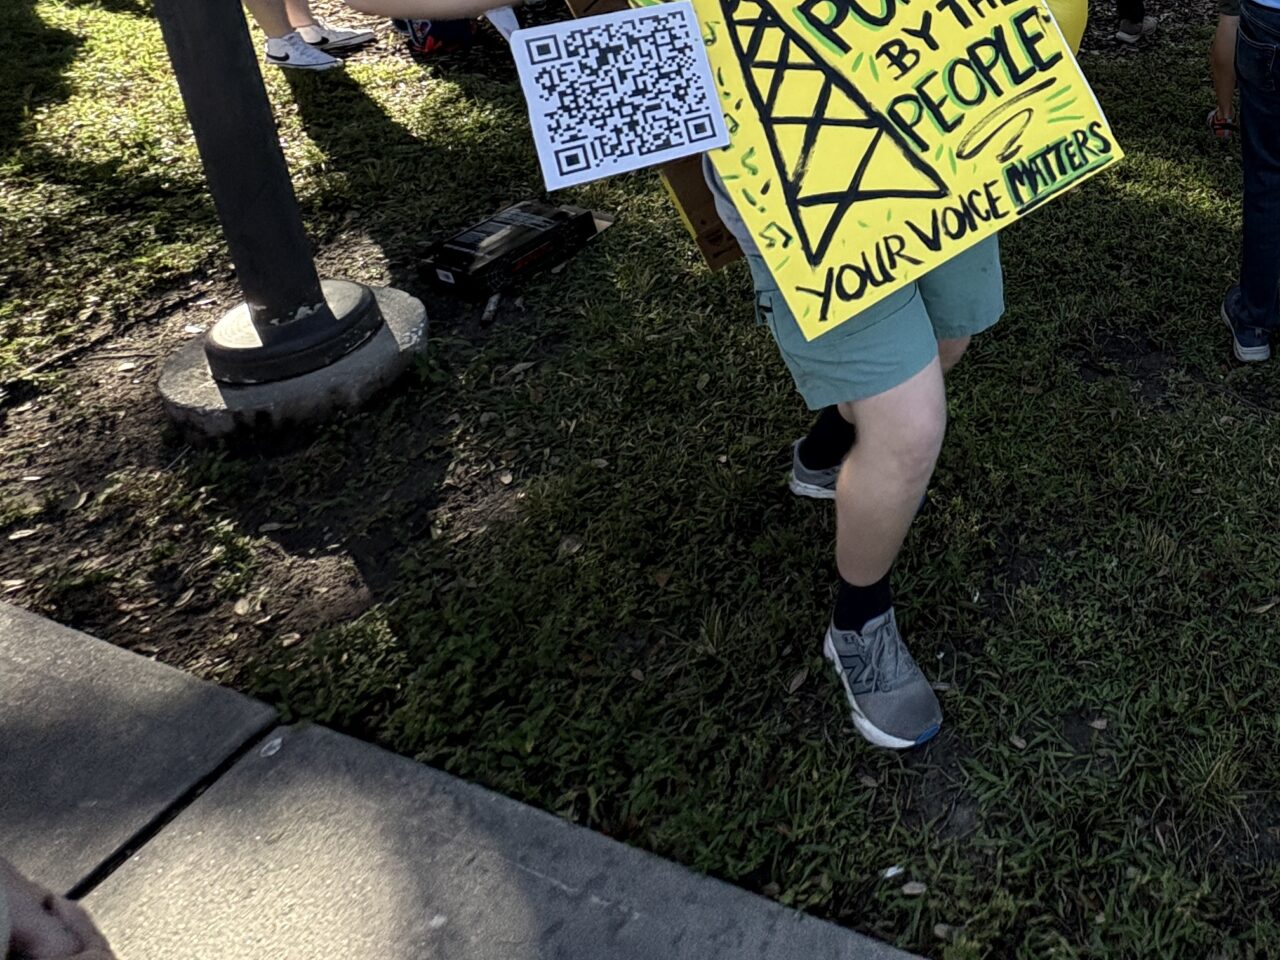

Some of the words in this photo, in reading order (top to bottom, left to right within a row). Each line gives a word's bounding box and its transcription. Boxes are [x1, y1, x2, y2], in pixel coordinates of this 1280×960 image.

[875, 12, 934, 81] BY
[886, 6, 1064, 153] PEOPLE
[794, 233, 925, 324] YOUR
[904, 179, 1012, 252] VOICE
[1003, 121, 1113, 205] MATTERS
